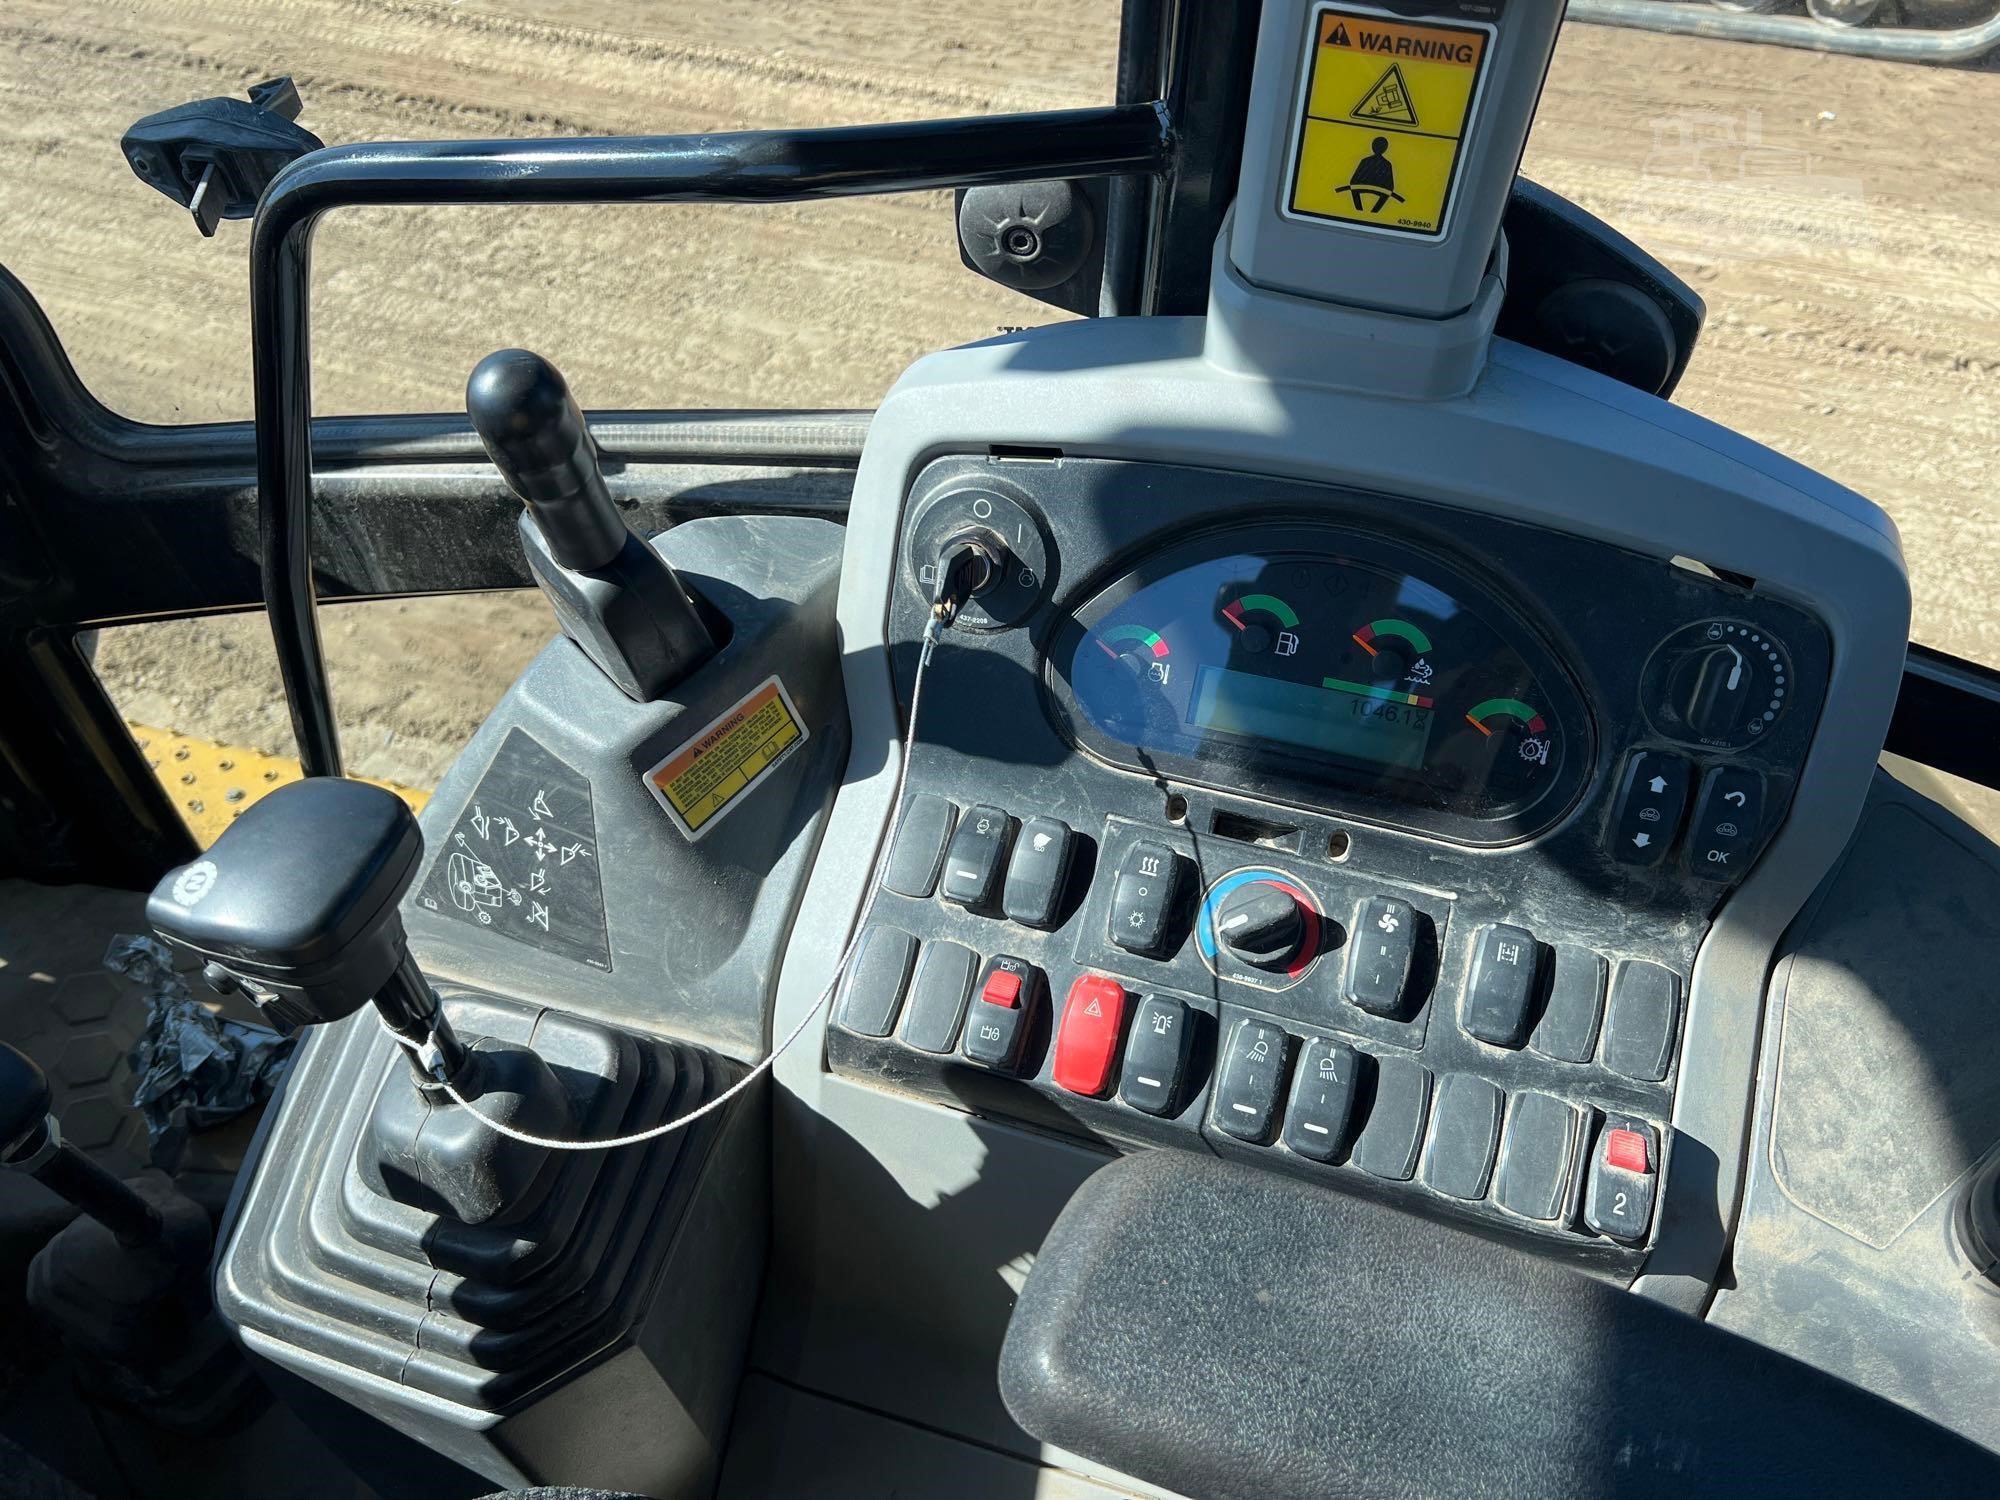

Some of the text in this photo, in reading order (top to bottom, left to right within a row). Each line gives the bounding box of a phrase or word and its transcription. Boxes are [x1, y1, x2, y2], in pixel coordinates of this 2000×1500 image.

[1359, 30, 1475, 64] WARNING
[1351, 699, 1411, 725] 1046.1
[701, 713, 745, 749] WARNING
[1707, 849, 1730, 864] OK
[1625, 1122, 1630, 1132] 1
[1612, 1192, 1627, 1216] 2
